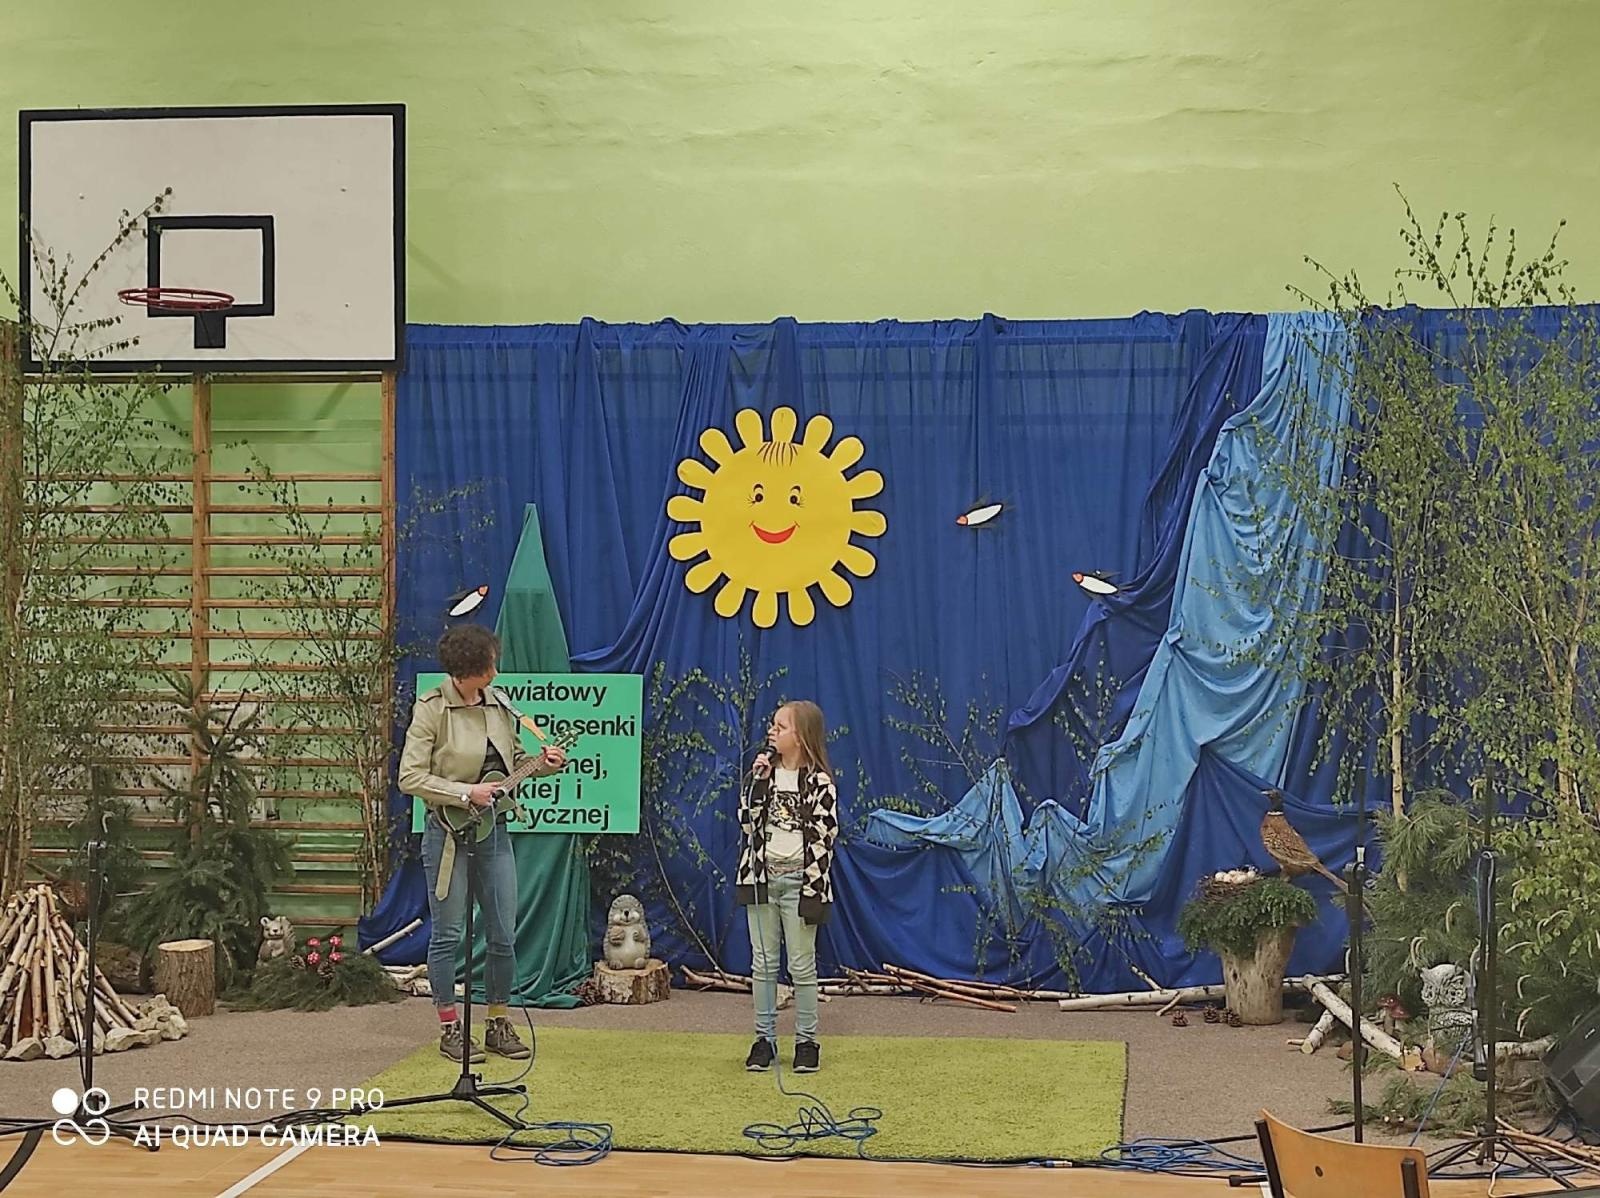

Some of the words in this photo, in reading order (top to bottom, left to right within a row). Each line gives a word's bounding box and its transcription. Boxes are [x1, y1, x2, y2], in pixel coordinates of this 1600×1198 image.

[493, 680, 607, 708] wiatowy
[533, 714, 635, 737] Piosenki
[560, 753, 607, 780] nej,
[576, 779, 582, 800] i
